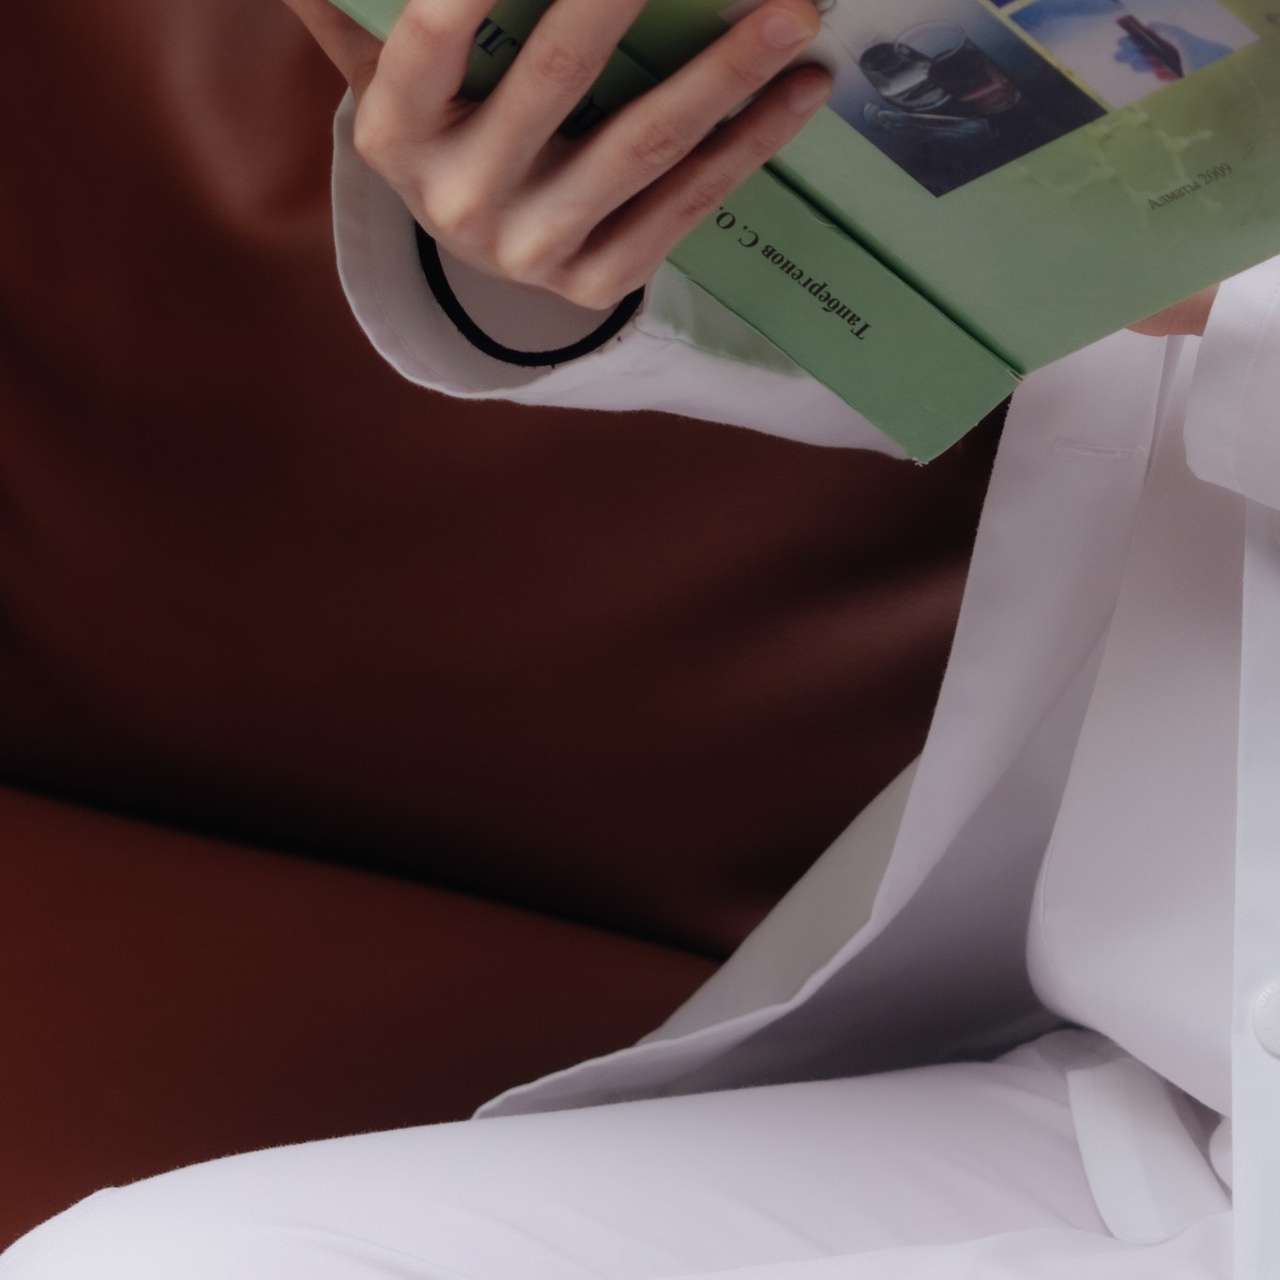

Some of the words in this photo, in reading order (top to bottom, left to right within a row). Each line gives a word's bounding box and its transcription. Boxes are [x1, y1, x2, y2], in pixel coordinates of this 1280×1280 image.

[1148, 177, 1202, 211] Алматы
[1199, 161, 1233, 186] 2009
[715, 205, 736, 230] О.
[737, 225, 760, 249] С.
[760, 243, 872, 341] Тапбергенов
